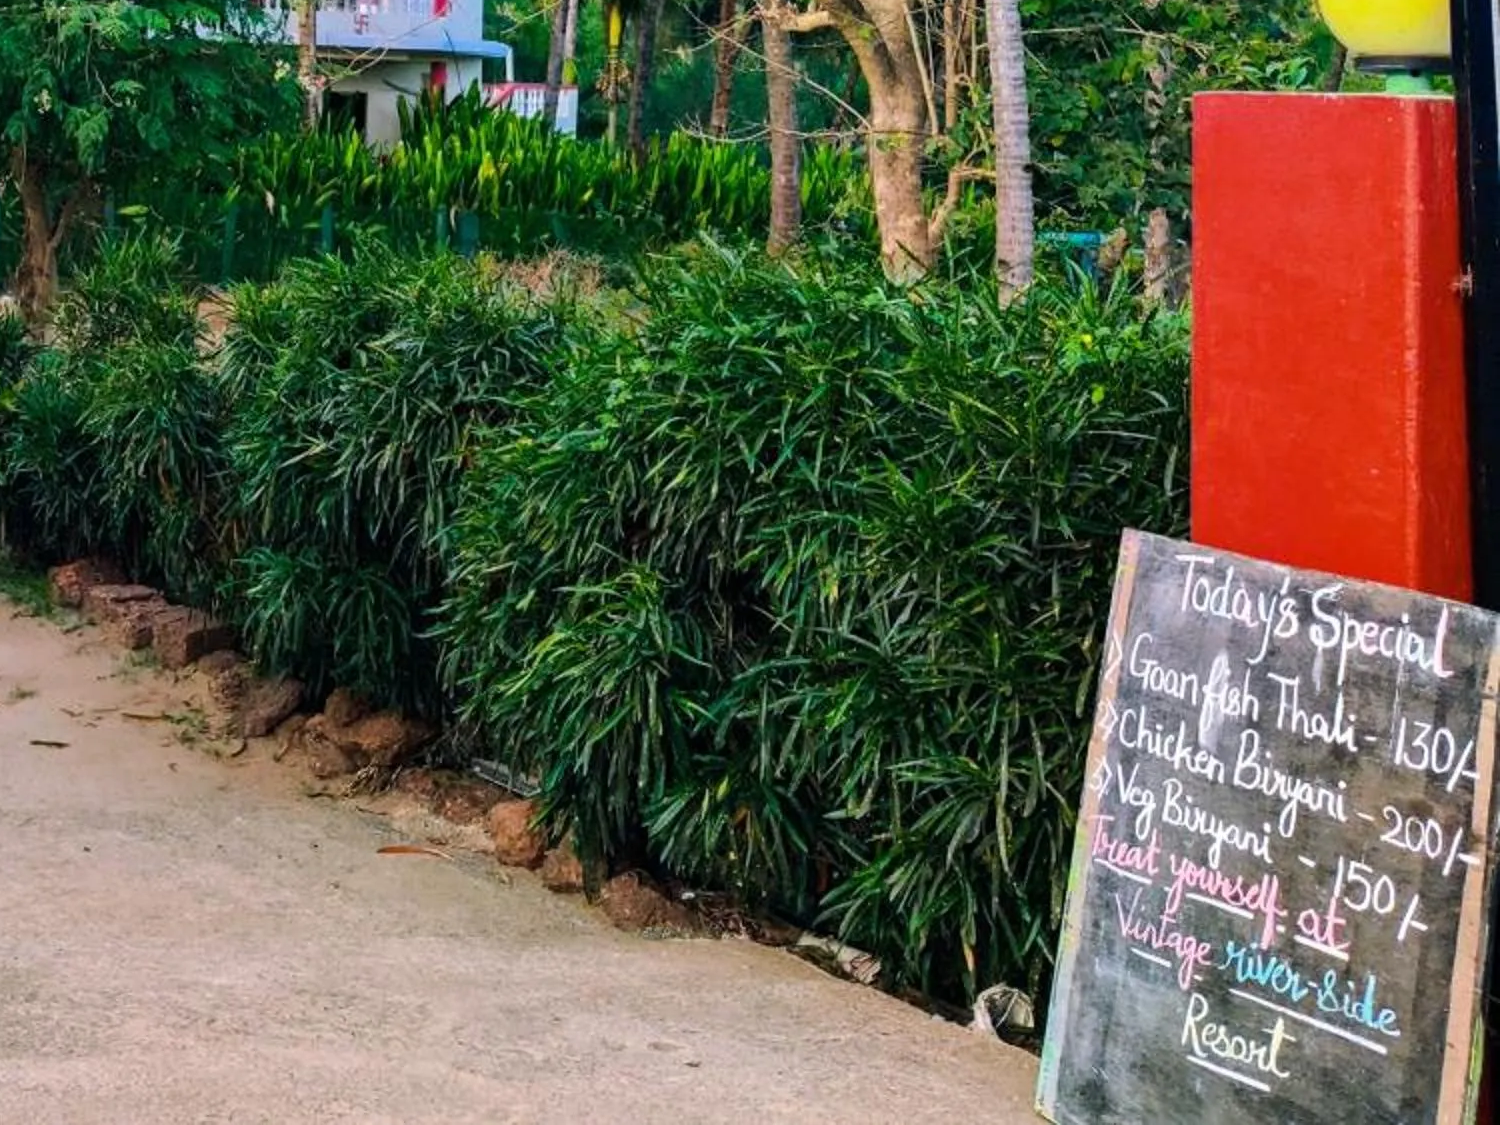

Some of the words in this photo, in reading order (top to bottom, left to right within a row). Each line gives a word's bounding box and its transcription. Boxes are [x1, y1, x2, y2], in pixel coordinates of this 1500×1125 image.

[1175, 554, 1299, 665] Today's
[1309, 583, 1454, 686] Special
[1267, 672, 1358, 752] Thali
[1116, 762, 1156, 841] Veg
[1162, 778, 1274, 870] Biryani
[1119, 705, 1224, 784] Chicken
[1233, 729, 1348, 838] Biryani
[1086, 815, 1162, 875] Treat
[1165, 854, 1288, 951] yourself
[1297, 896, 1351, 951] at
[1115, 887, 1212, 991] Vintage
[1181, 993, 1297, 1078] Resort
